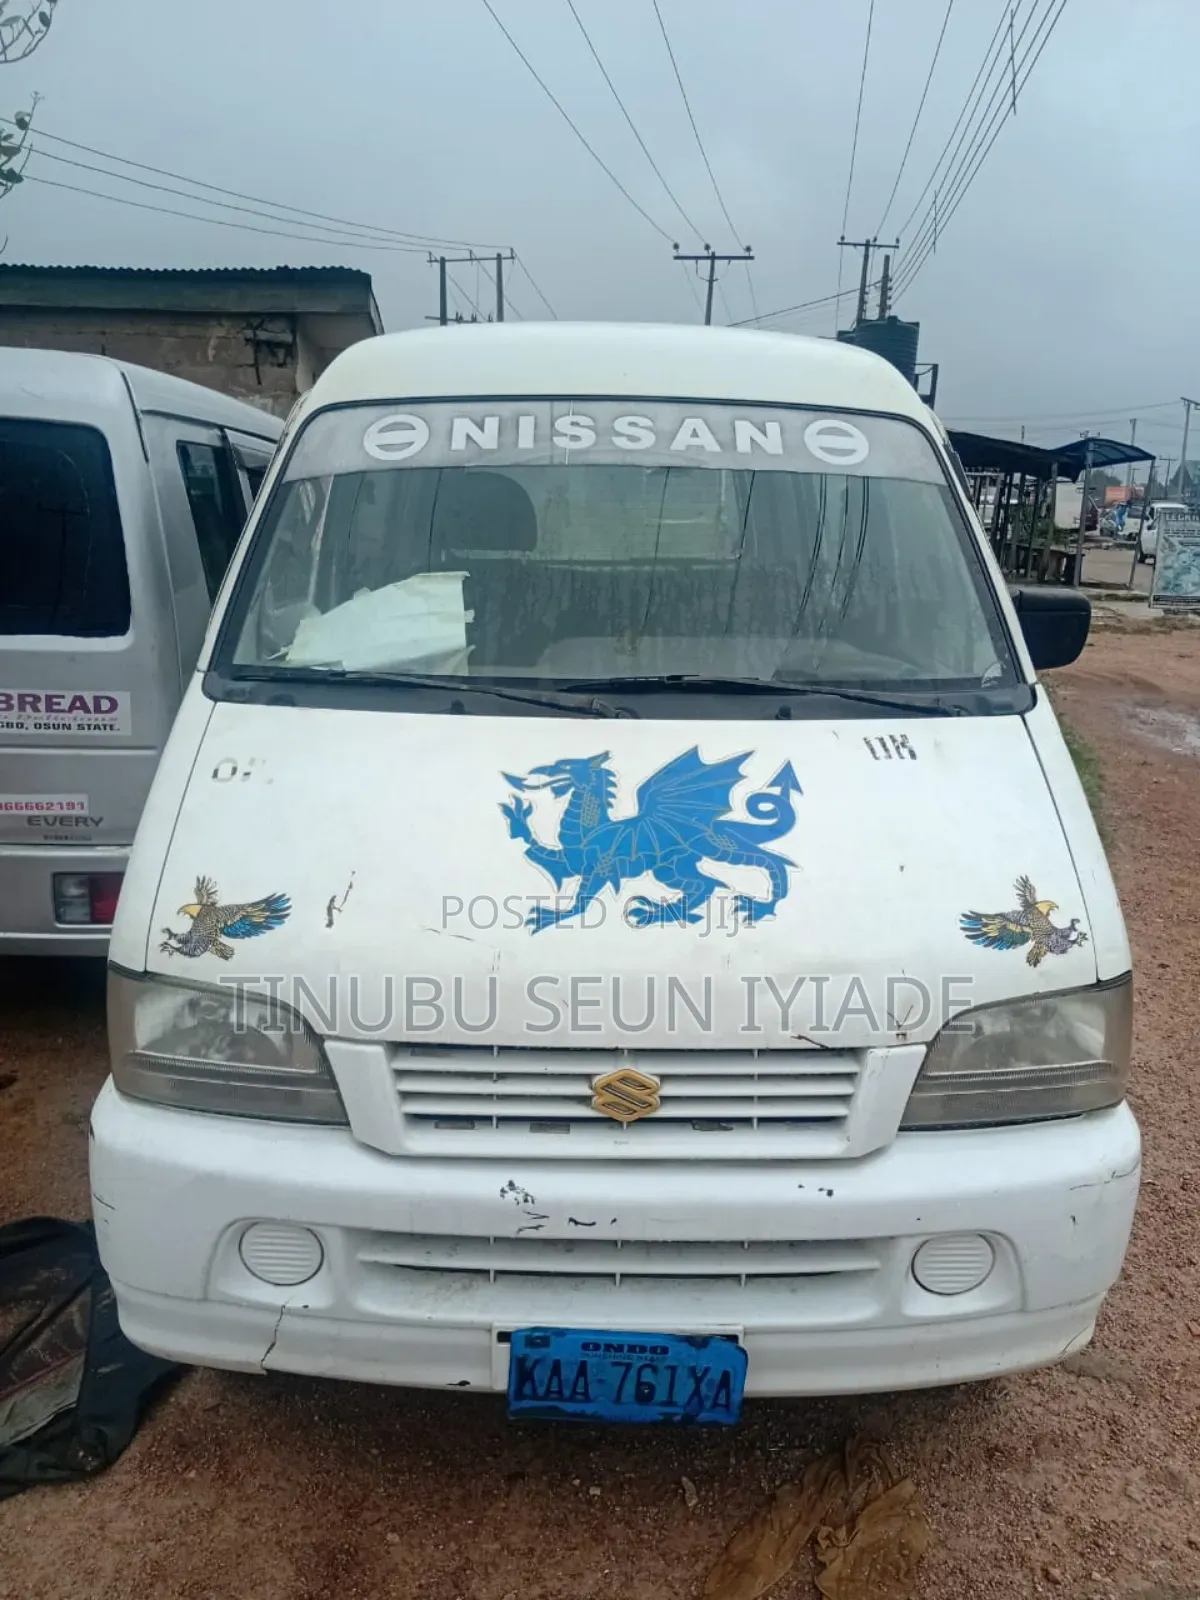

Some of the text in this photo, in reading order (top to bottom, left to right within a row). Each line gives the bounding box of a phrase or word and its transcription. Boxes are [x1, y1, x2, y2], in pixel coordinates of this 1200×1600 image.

[450, 415, 784, 455] NISSAN
[0, 692, 119, 714] BREAD
[34, 721, 72, 731] OSUN
[26, 815, 105, 828] EVERY
[580, 1341, 670, 1355] ONDO
